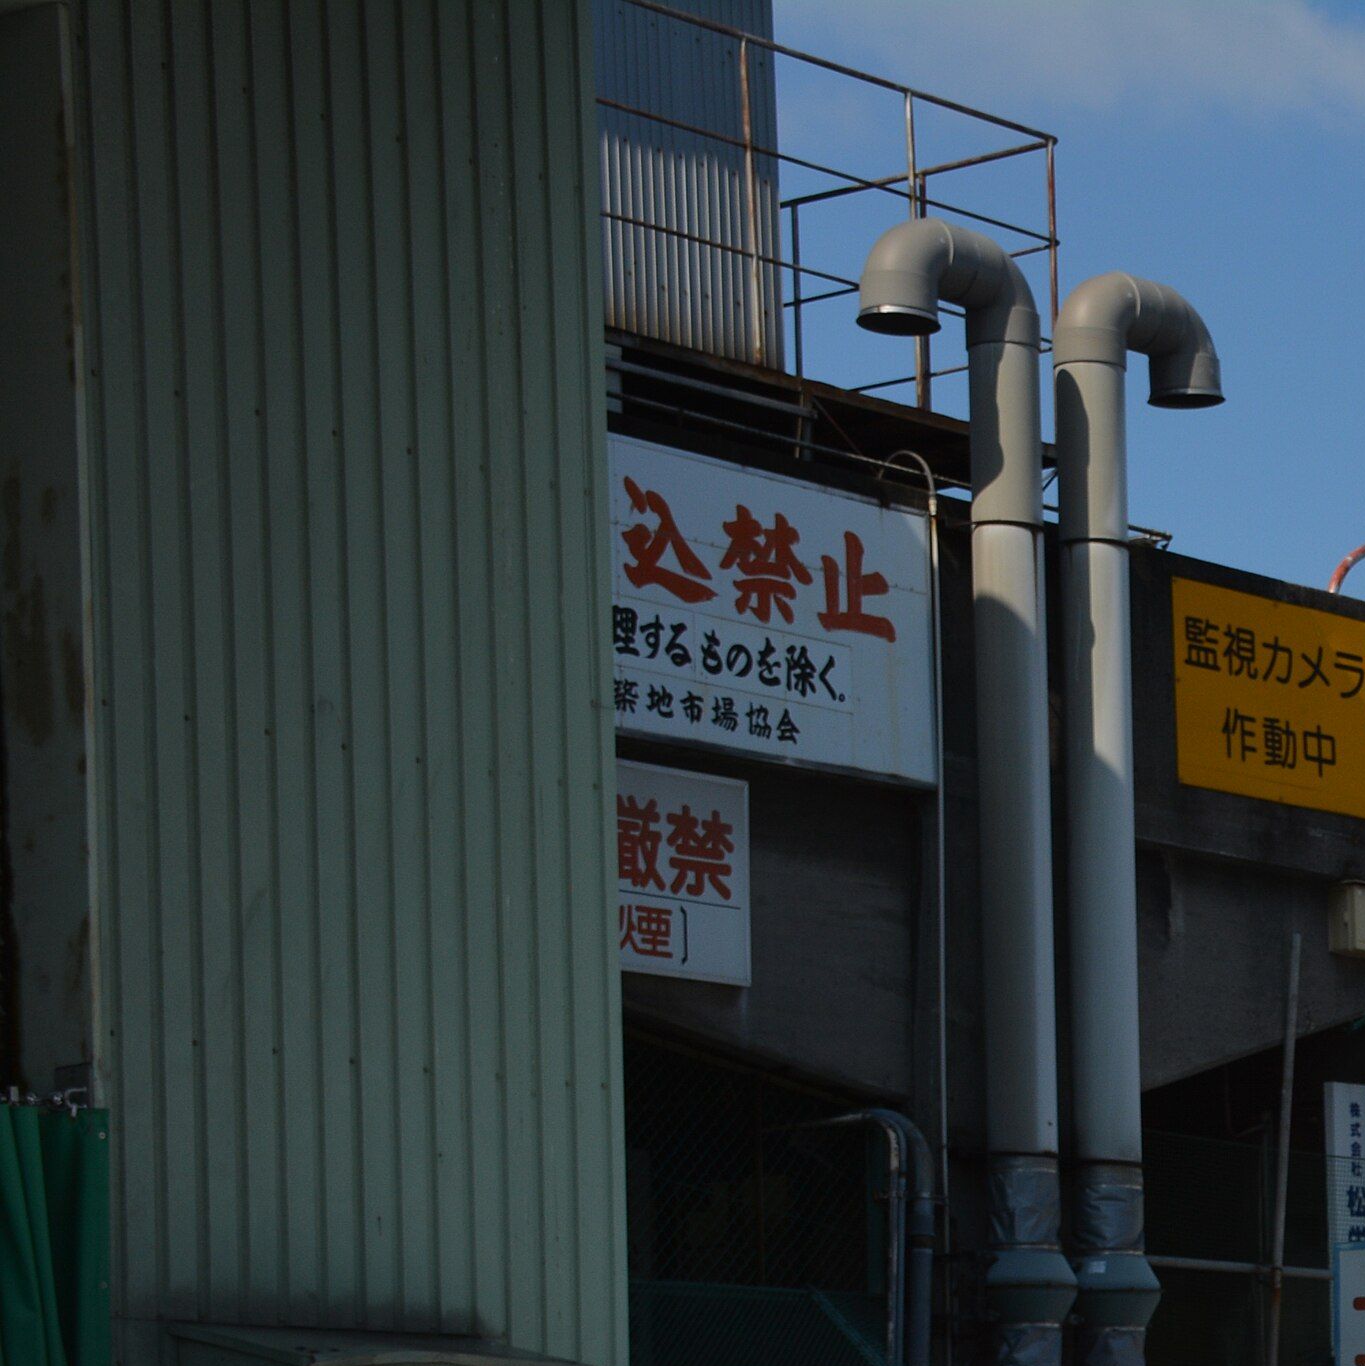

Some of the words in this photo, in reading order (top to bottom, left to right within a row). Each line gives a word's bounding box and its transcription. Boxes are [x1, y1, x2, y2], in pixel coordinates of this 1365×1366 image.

[623, 476, 896, 643] 込禁止
[1184, 615, 1365, 698] 監視カメラ
[1222, 707, 1337, 778] 作動中
